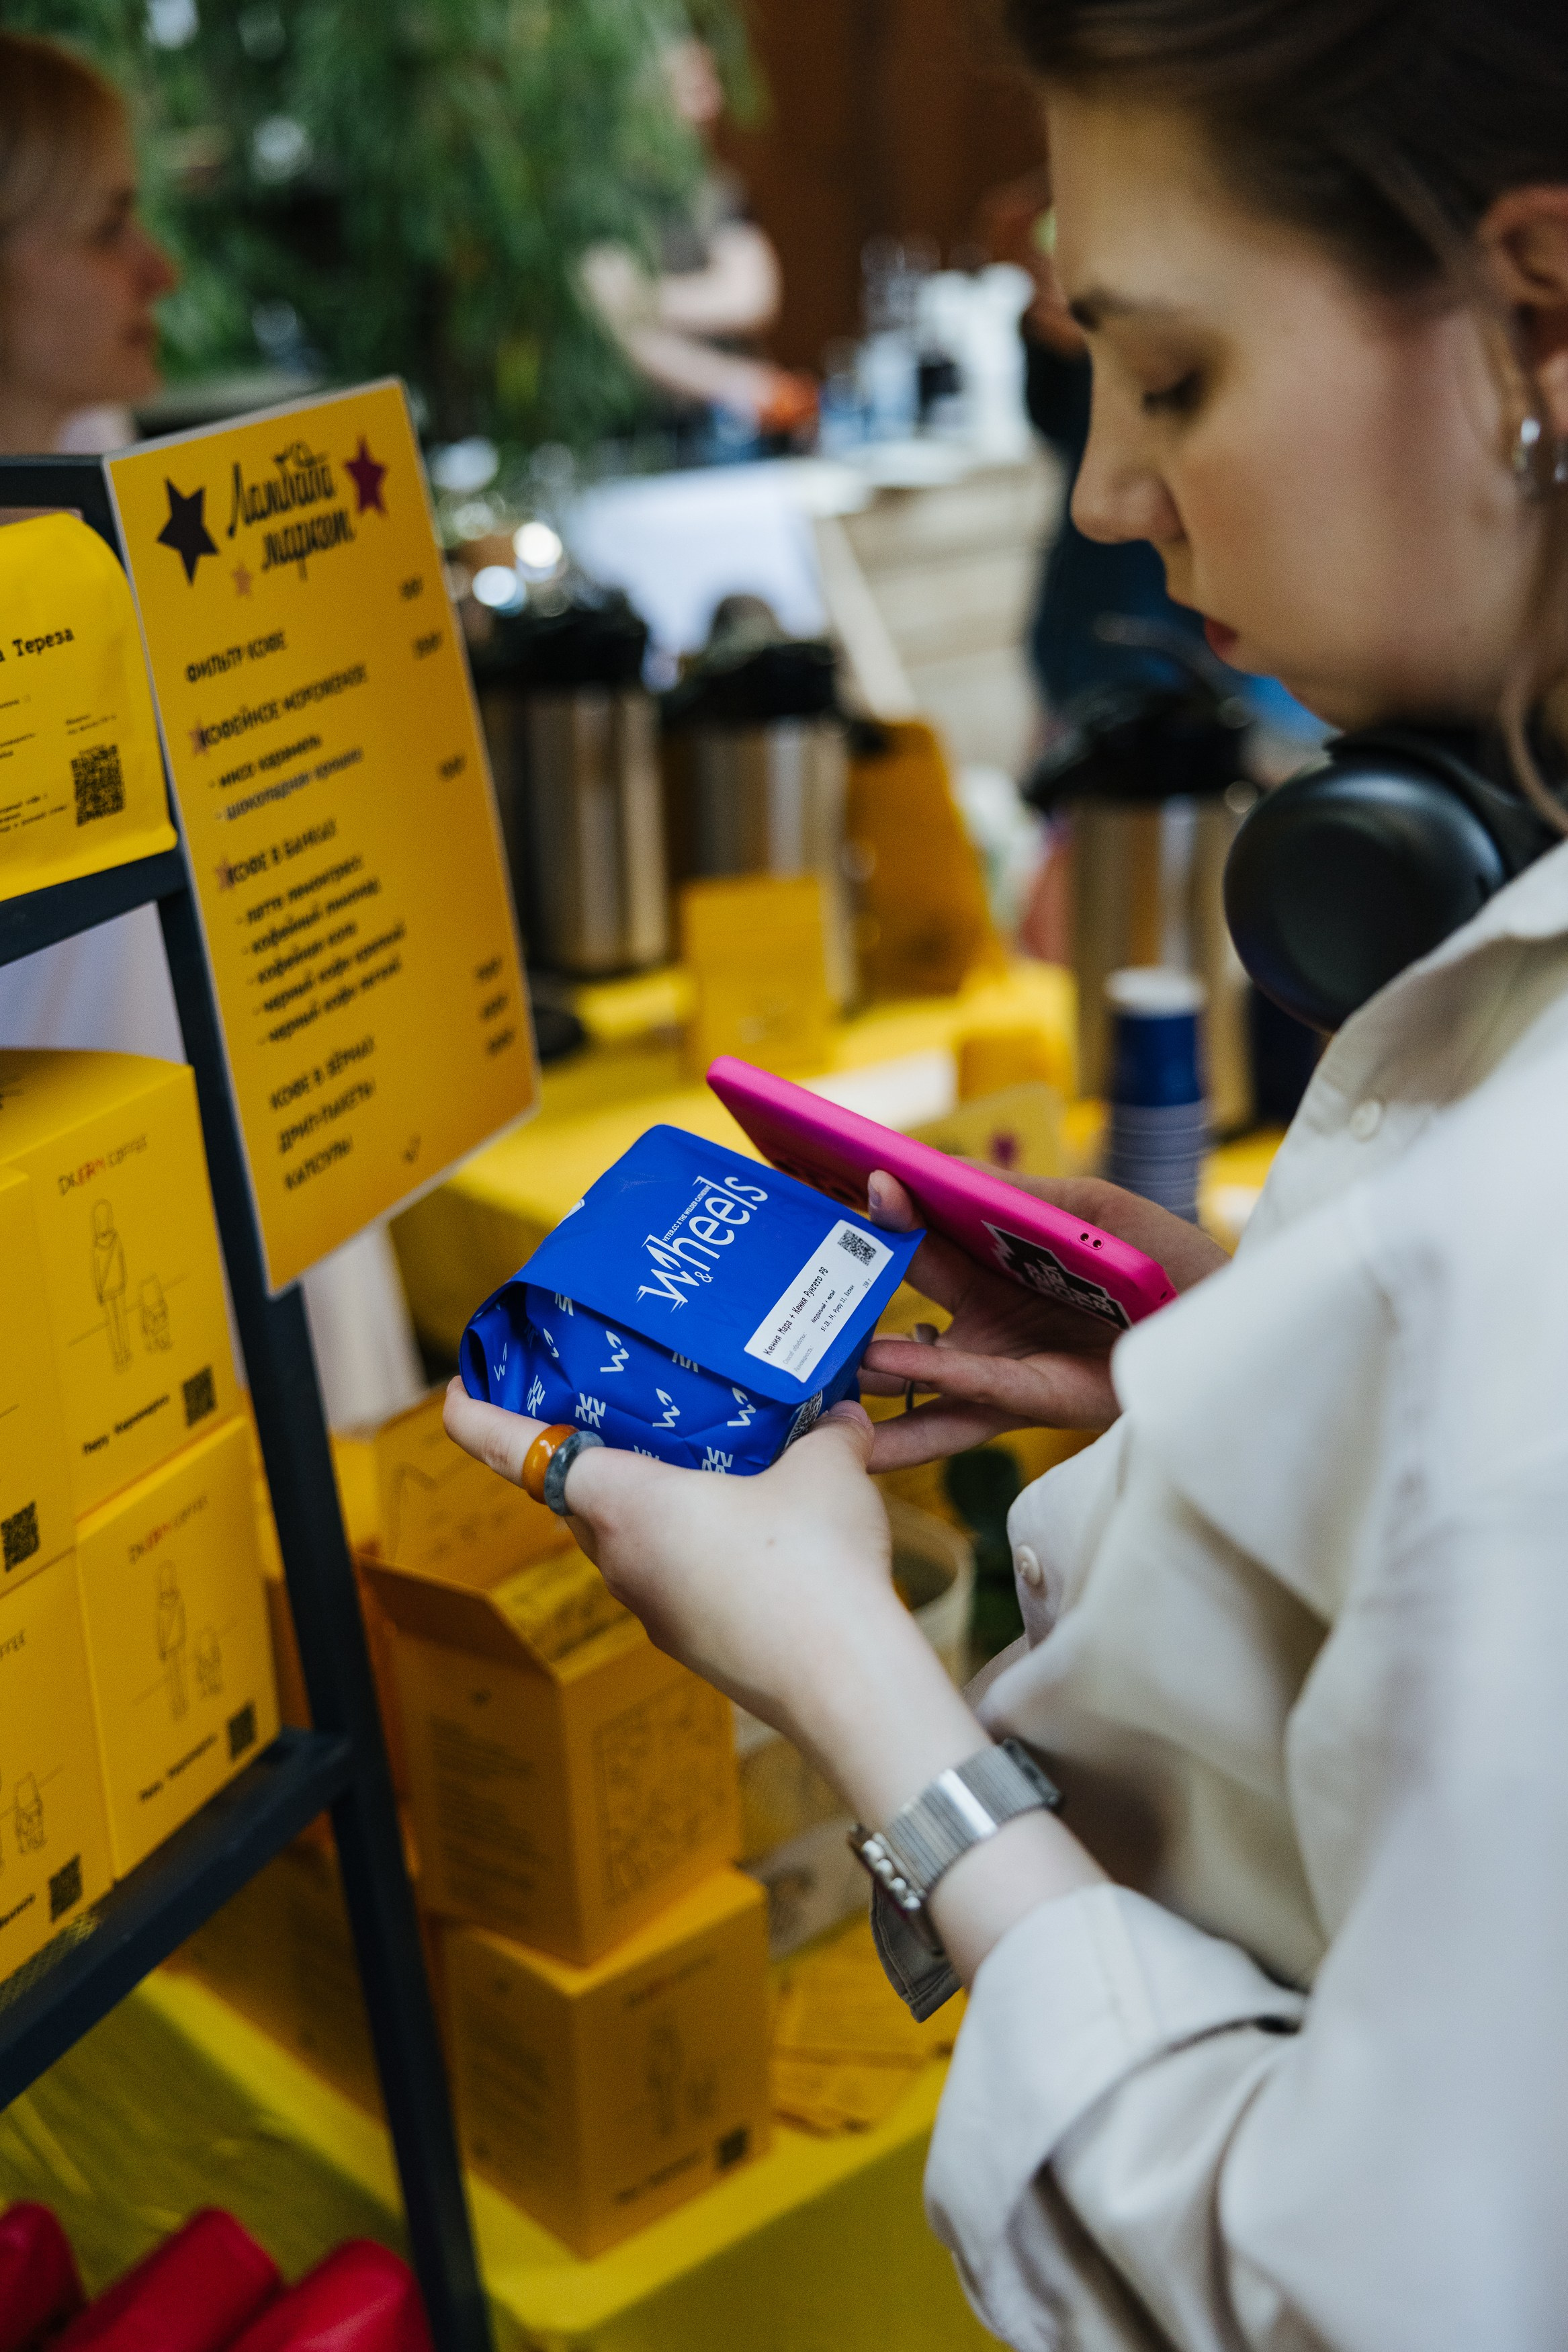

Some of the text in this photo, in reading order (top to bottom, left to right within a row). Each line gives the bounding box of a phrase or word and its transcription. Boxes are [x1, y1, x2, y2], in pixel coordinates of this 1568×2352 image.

[12, 628, 75, 657] Тереза
[662, 1224, 679, 1242] VETER.CC
[678, 1214, 687, 1222] THE
[684, 1201, 698, 1215] WELDER
[763, 1335, 782, 1355] Кения
[777, 1320, 792, 1335] Мара
[791, 1297, 808, 1314] Кения
[803, 1275, 823, 1298] Рунгето
